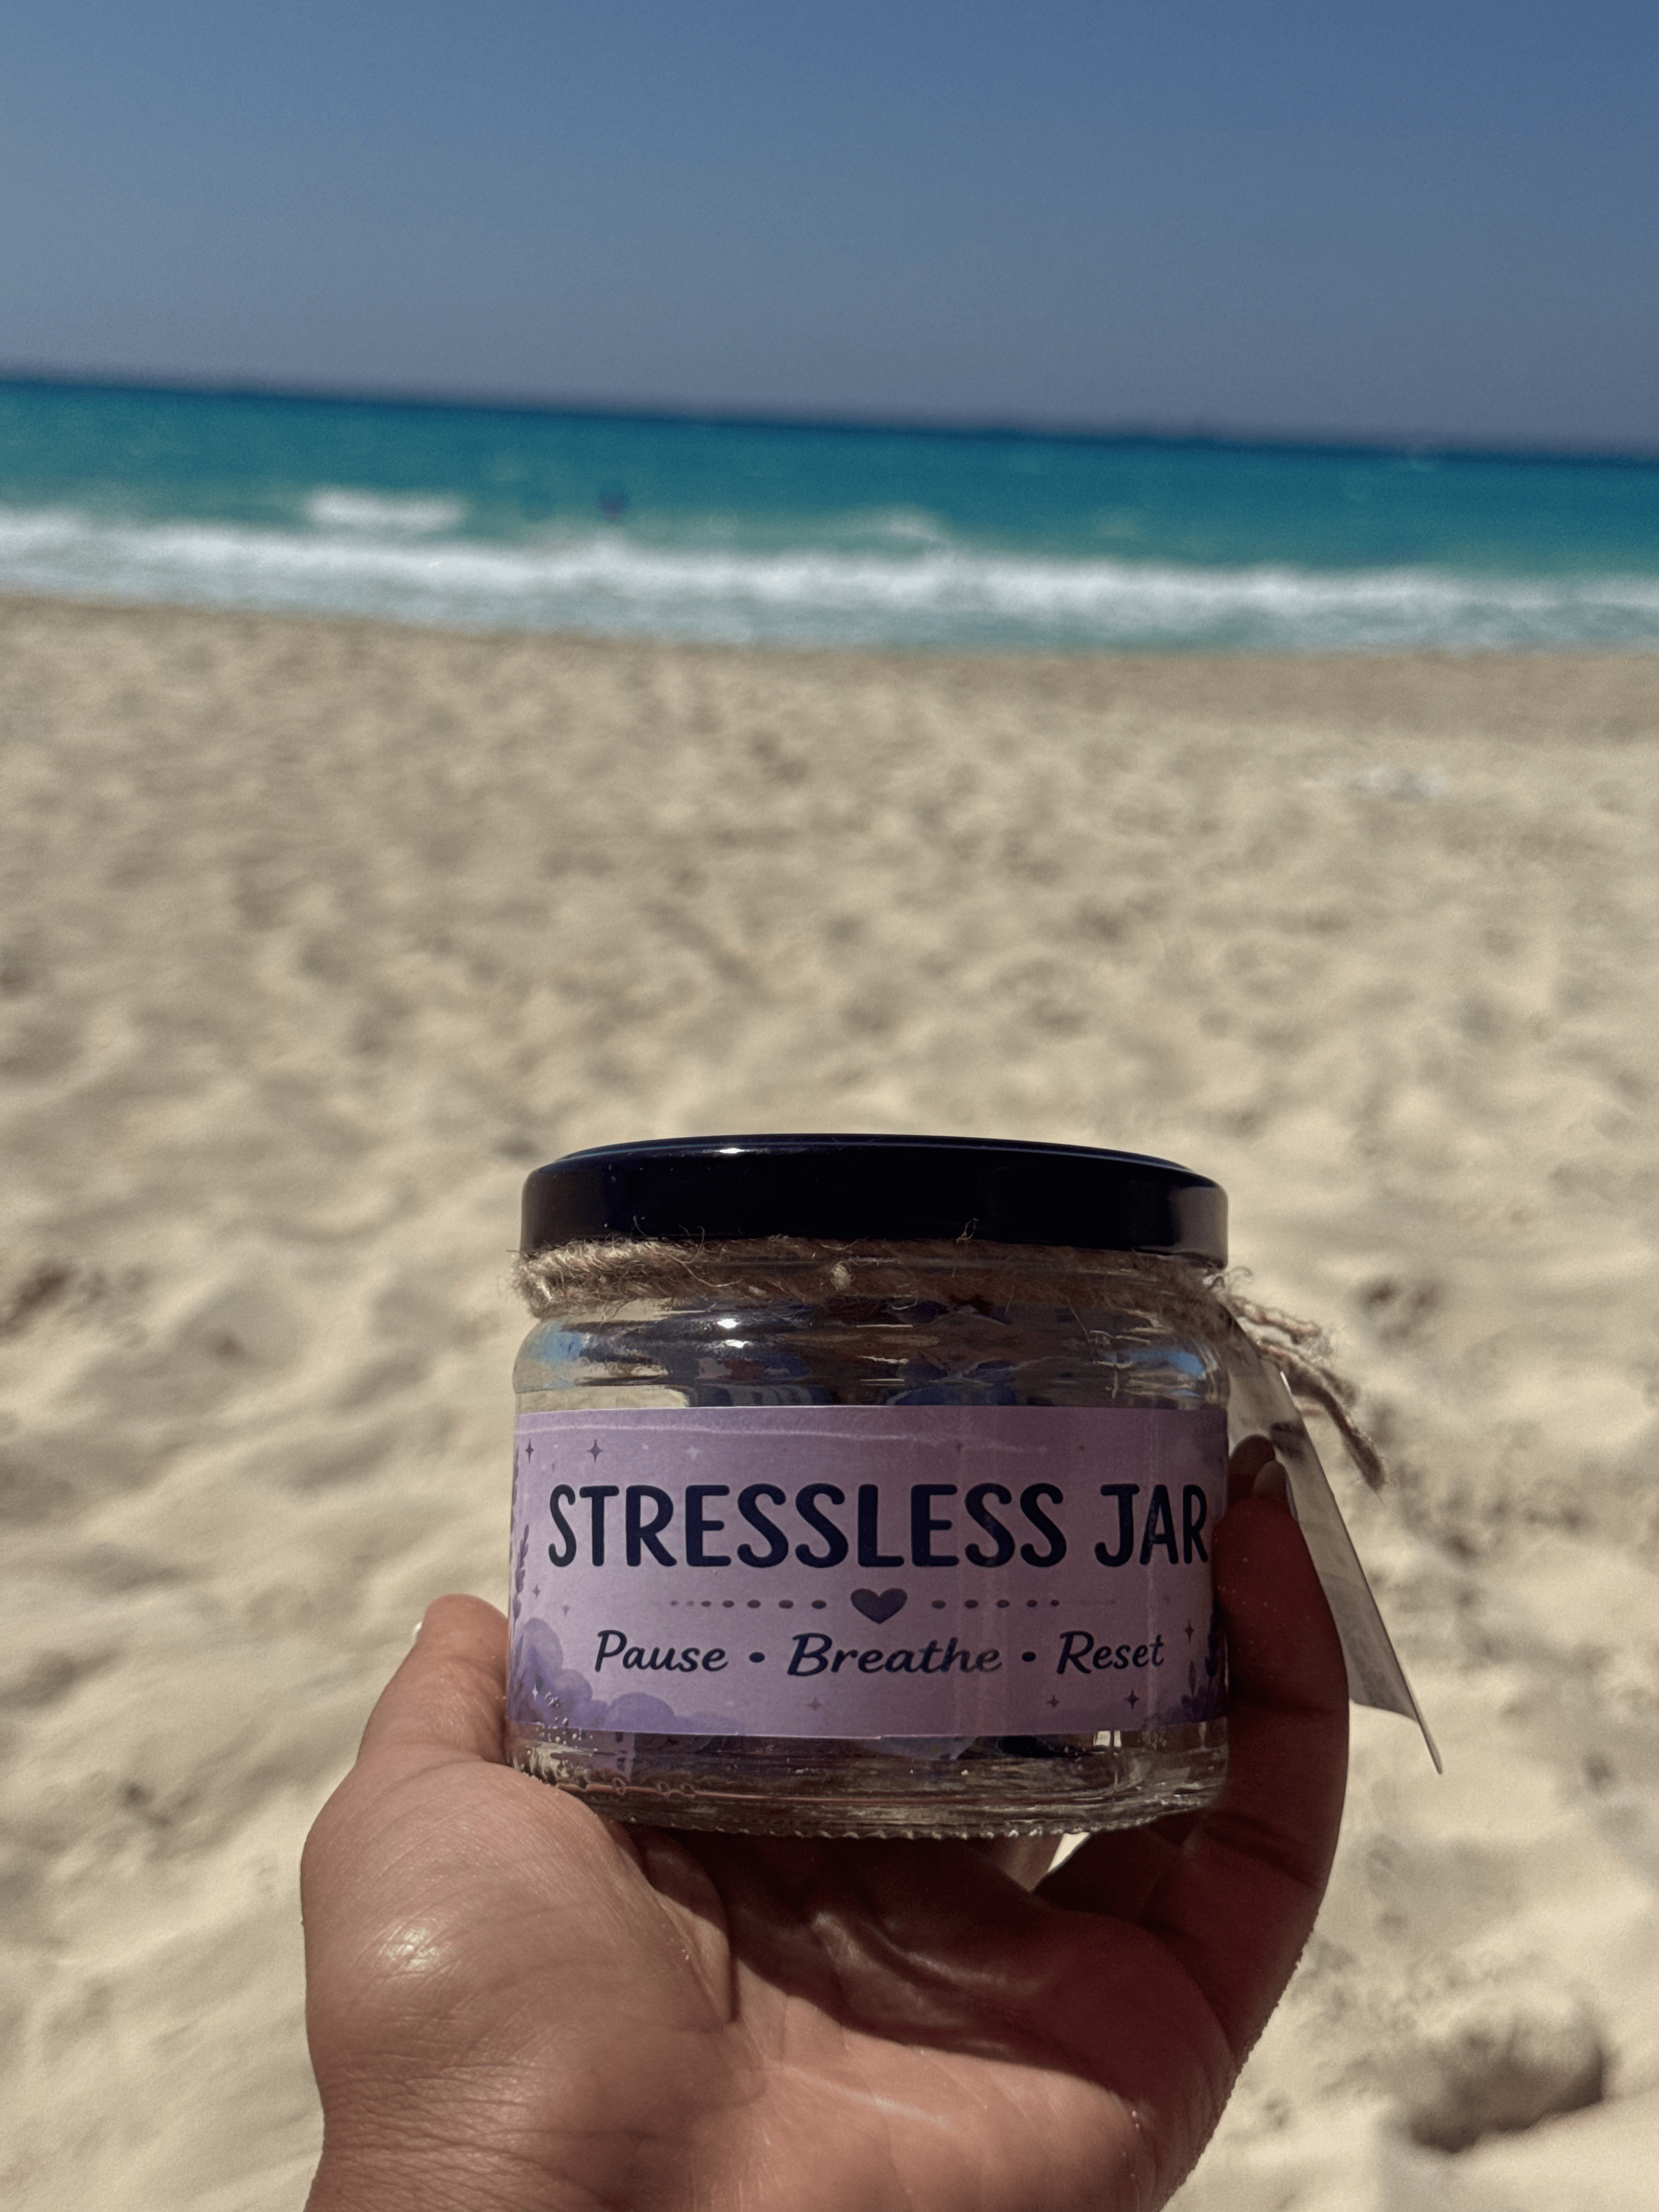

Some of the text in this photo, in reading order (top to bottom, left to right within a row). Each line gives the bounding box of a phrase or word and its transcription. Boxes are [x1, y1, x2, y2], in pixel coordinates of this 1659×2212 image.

[548, 1483, 1208, 1568] STRESSLESS JAR
[594, 1629, 1165, 1677] Pause Breathe Reset
